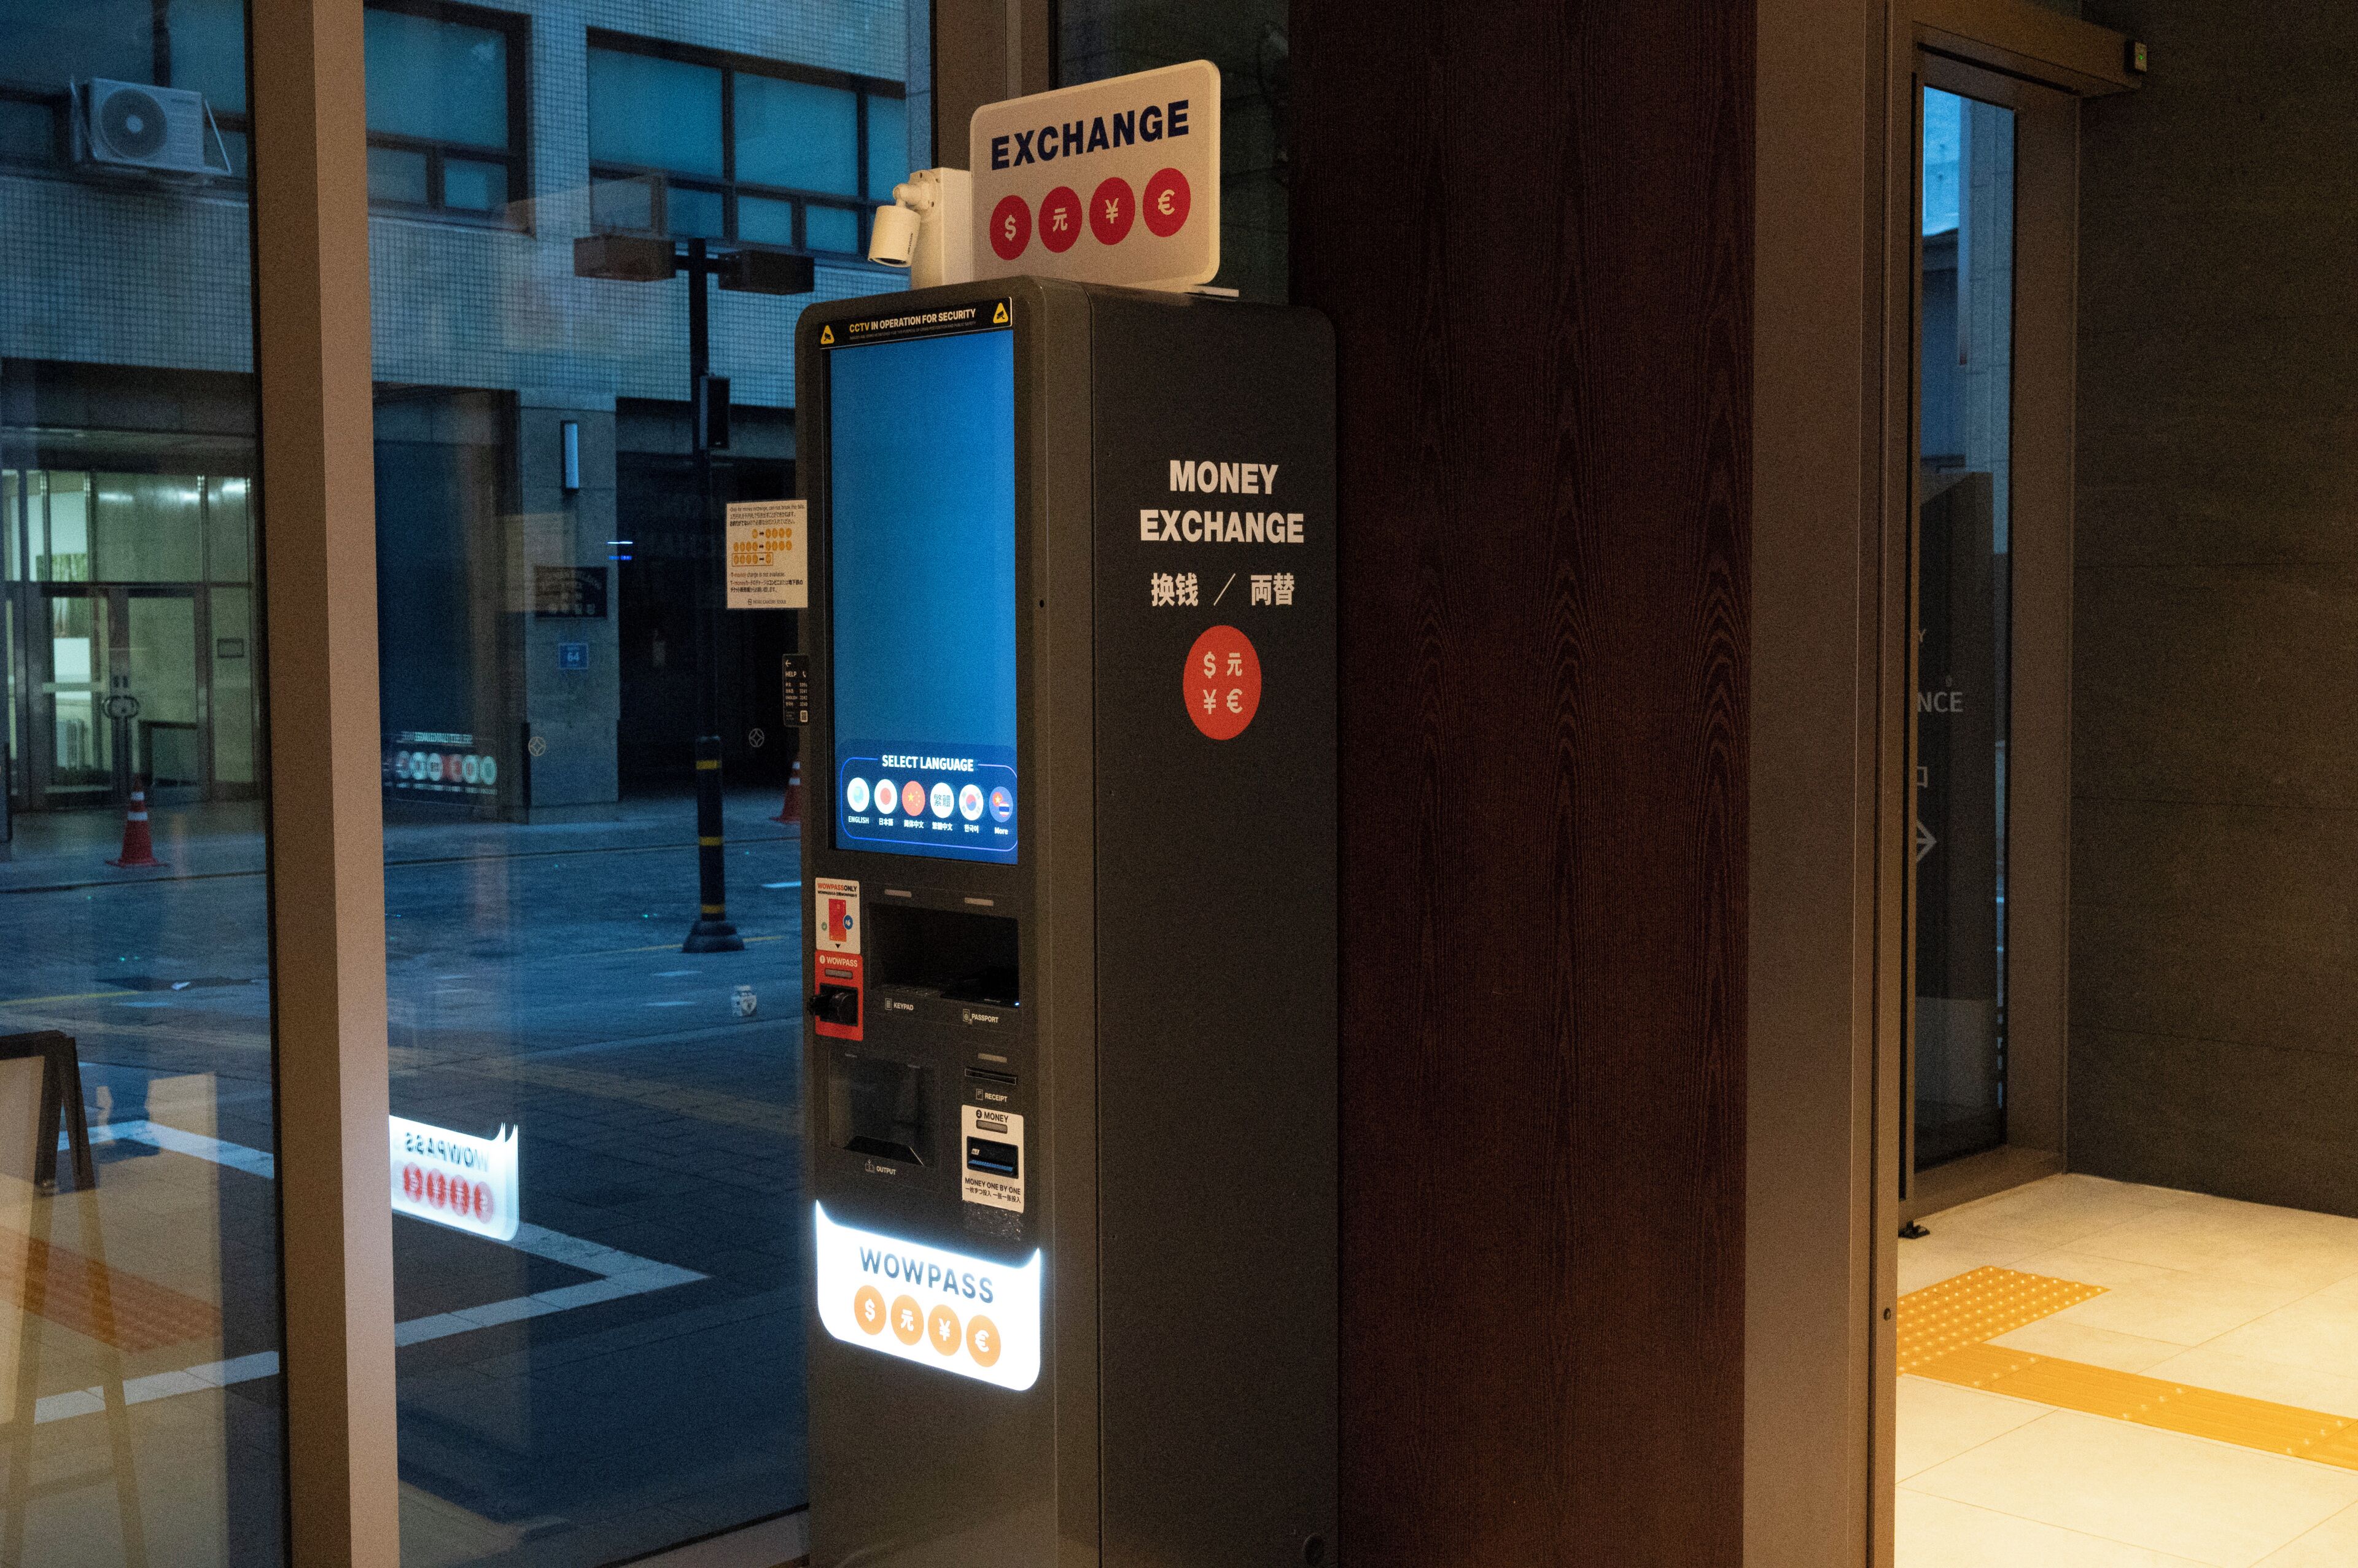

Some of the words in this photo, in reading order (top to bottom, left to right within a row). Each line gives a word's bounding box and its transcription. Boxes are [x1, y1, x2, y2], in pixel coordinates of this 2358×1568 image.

[990, 99, 1189, 171] EXCHANGE
[1053, 208, 1068, 232] 元
[1158, 189, 1175, 215] €
[849, 322, 870, 333] CCTV
[871, 321, 879, 330] IN
[879, 316, 921, 329] OPERATION
[922, 314, 937, 324] FOR
[938, 308, 976, 322] SECURITY
[1169, 460, 1279, 494] MONEY
[1140, 509, 1304, 543] EXCHANGE
[1151, 572, 1199, 607] 换钱
[1250, 572, 1294, 606] 両替
[1226, 653, 1243, 677] 元
[1226, 688, 1243, 714] €
[882, 755, 919, 769] SELECT
[920, 756, 974, 772] LANGUAGE
[933, 794, 951, 807] 繁體
[848, 815, 870, 824] ENGLISH
[879, 818, 893, 826] 日本語
[964, 824, 979, 834] 한국어
[827, 957, 858, 968] WOWPASS
[893, 1002, 914, 1011] KEYPAD
[971, 1013, 999, 1023] PASSPORT
[984, 1092, 1008, 1102] RECEIPT
[984, 1111, 1008, 1122] MONEY
[876, 1165, 896, 1175] OUTPUT
[965, 1178, 986, 1187] MONEY
[987, 1182, 998, 1190] ONE
[860, 1245, 994, 1304] WOWPASS
[900, 1308, 915, 1332] 元
[975, 1329, 990, 1353] €
